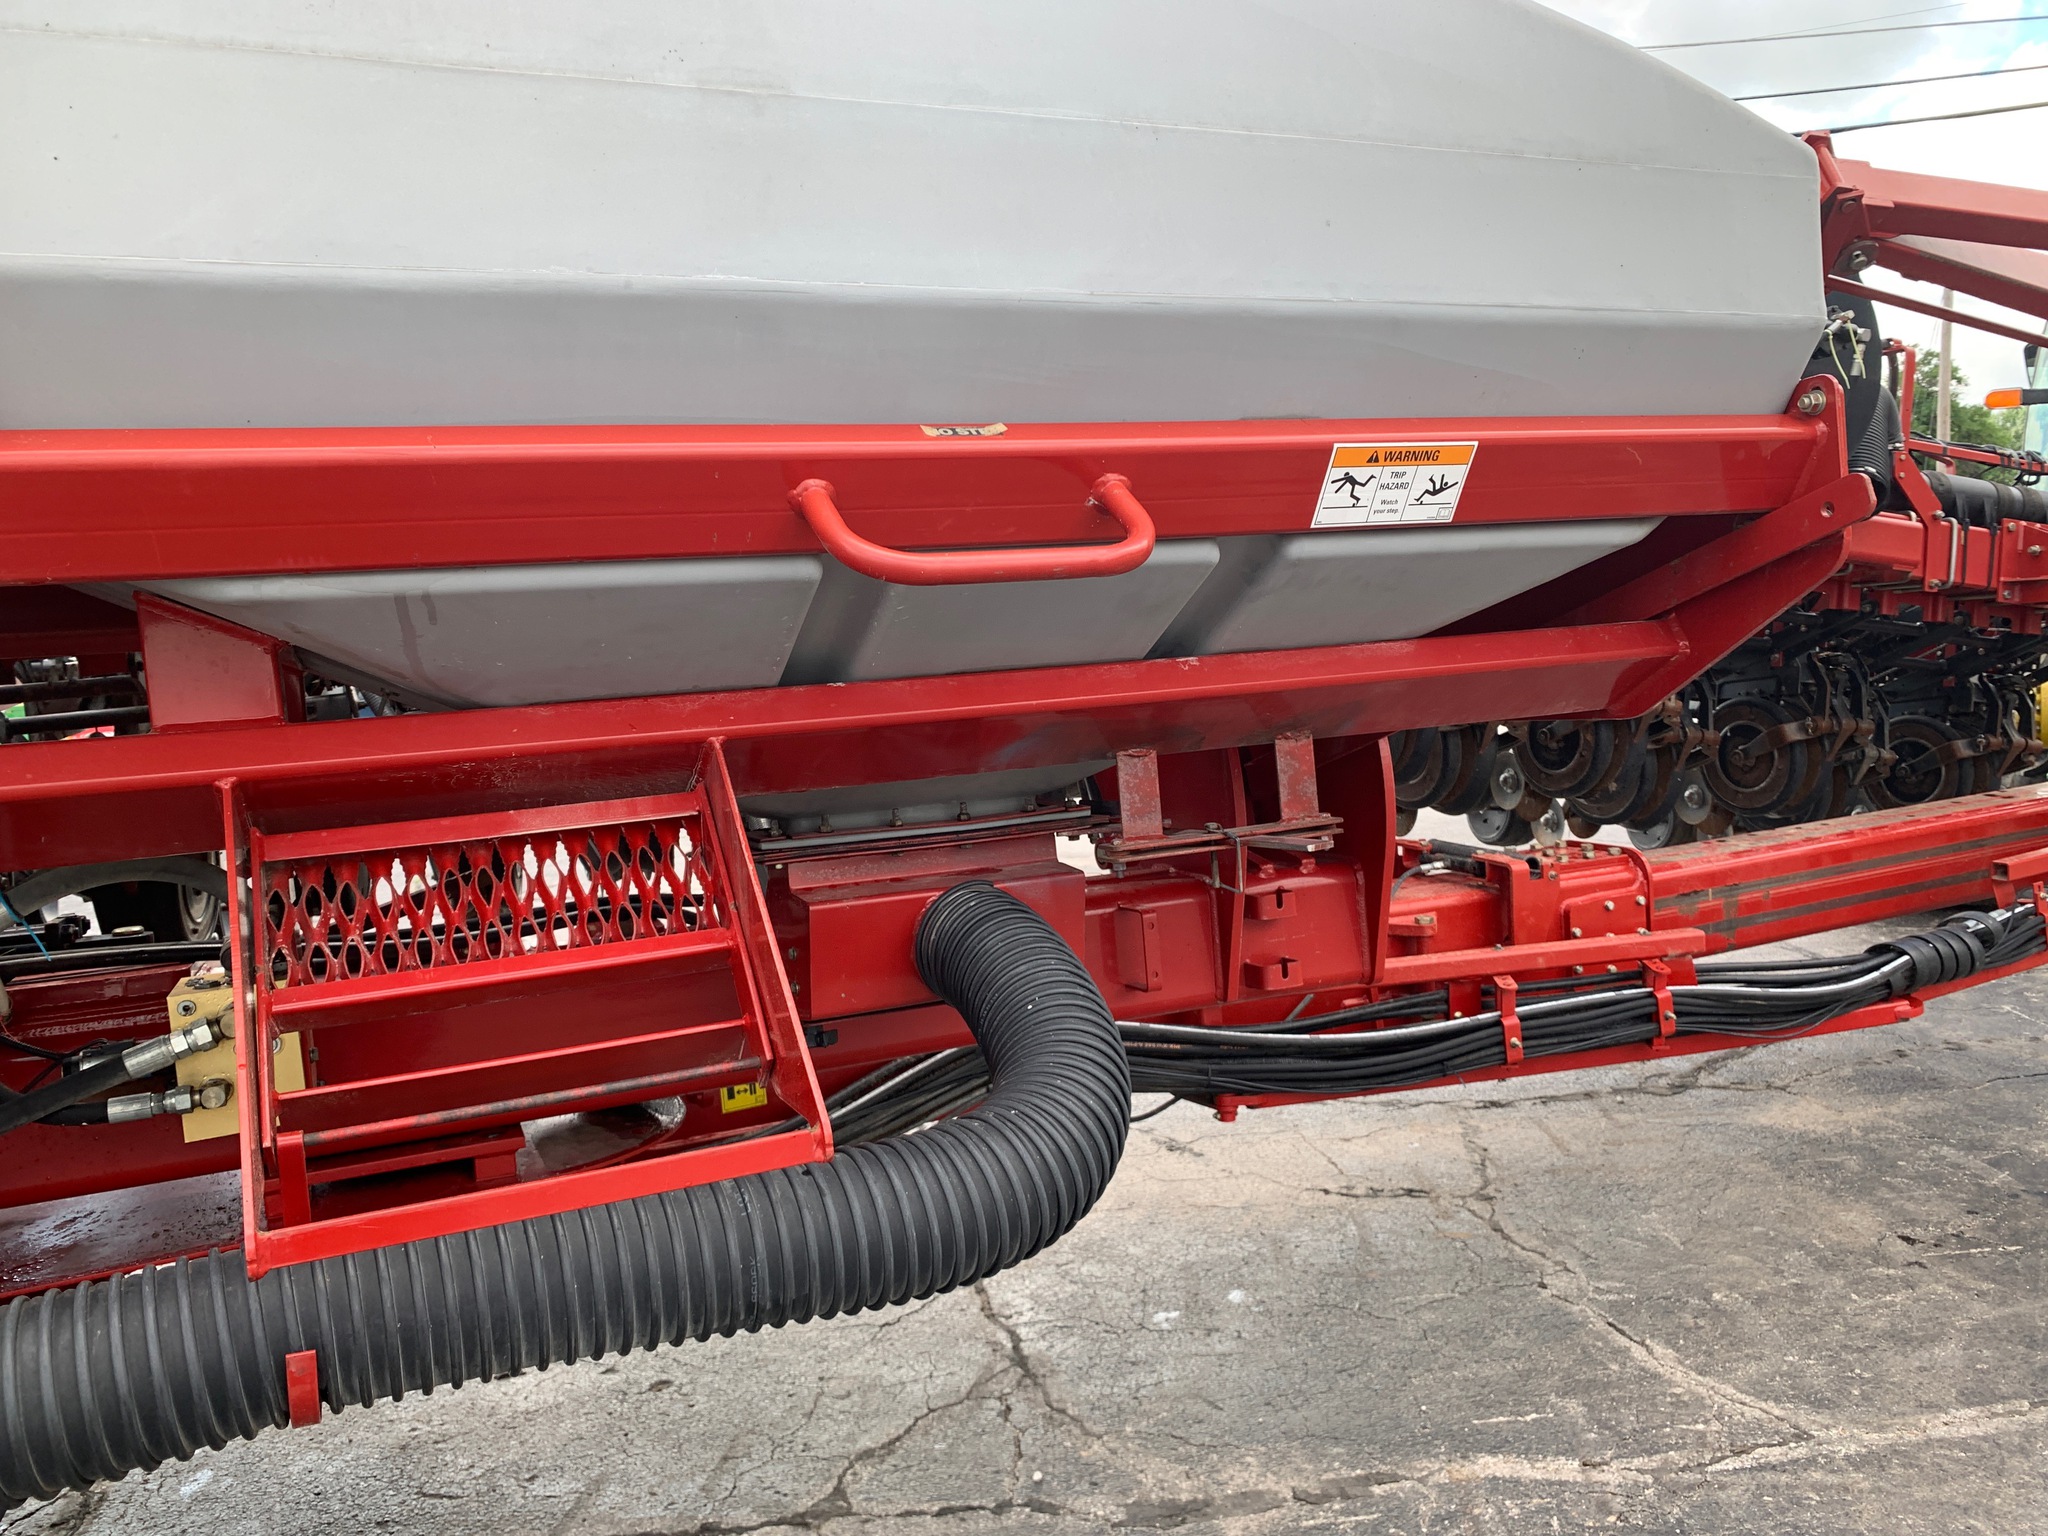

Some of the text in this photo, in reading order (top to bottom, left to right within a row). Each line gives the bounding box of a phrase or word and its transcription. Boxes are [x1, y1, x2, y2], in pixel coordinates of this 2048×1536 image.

[1383, 450, 1440, 462] WARNING
[1390, 471, 1407, 479] TRIP
[1379, 482, 1410, 490] HAZARD
